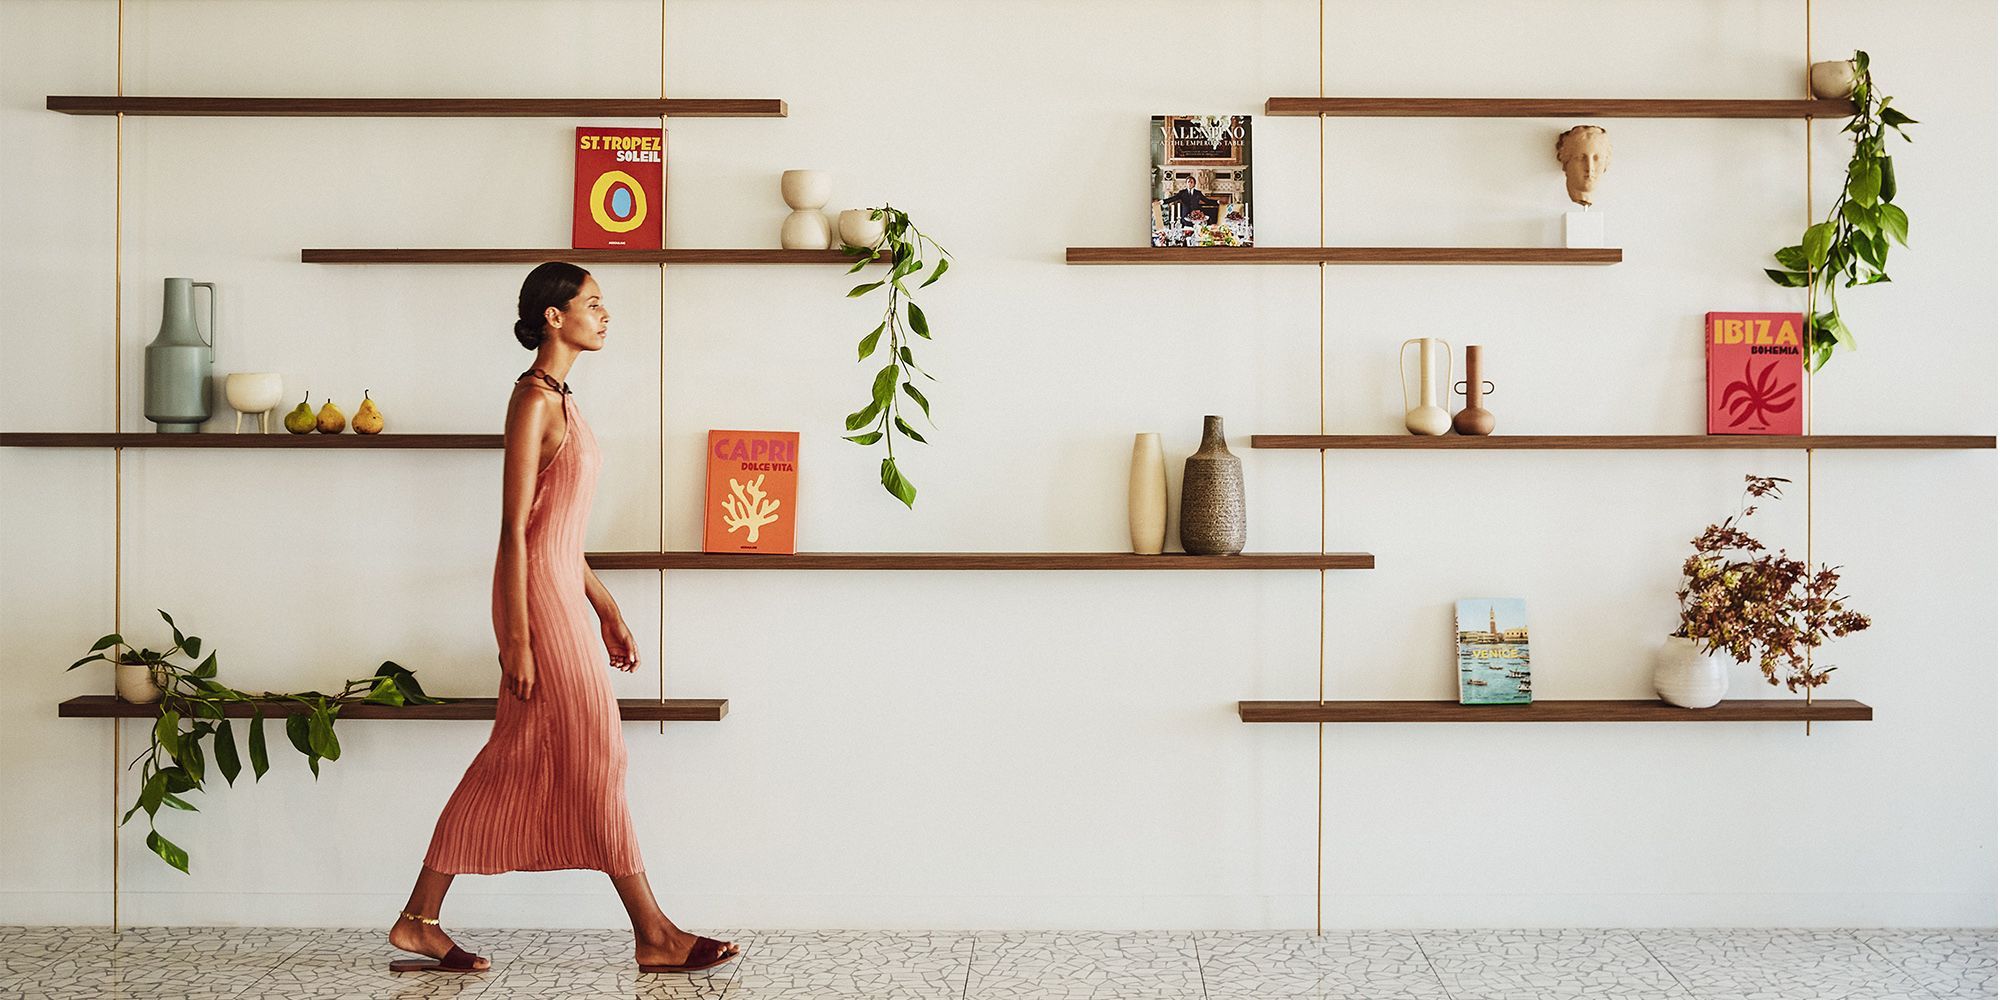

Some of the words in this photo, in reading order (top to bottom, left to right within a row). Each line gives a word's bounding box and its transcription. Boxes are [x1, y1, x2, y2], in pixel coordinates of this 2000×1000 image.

[1160, 126, 1245, 139] VALENTINO
[580, 136, 600, 150] ST.
[602, 136, 661, 151] TROPEZ
[616, 150, 661, 163] SOLEIL
[1714, 319, 1799, 345] IBIZA
[1751, 346, 1799, 355] BOHEMIA
[714, 438, 794, 462] CAPRI
[741, 462, 770, 471] DOLCE
[772, 463, 793, 472] VITA
[1472, 649, 1518, 659] VENICE
